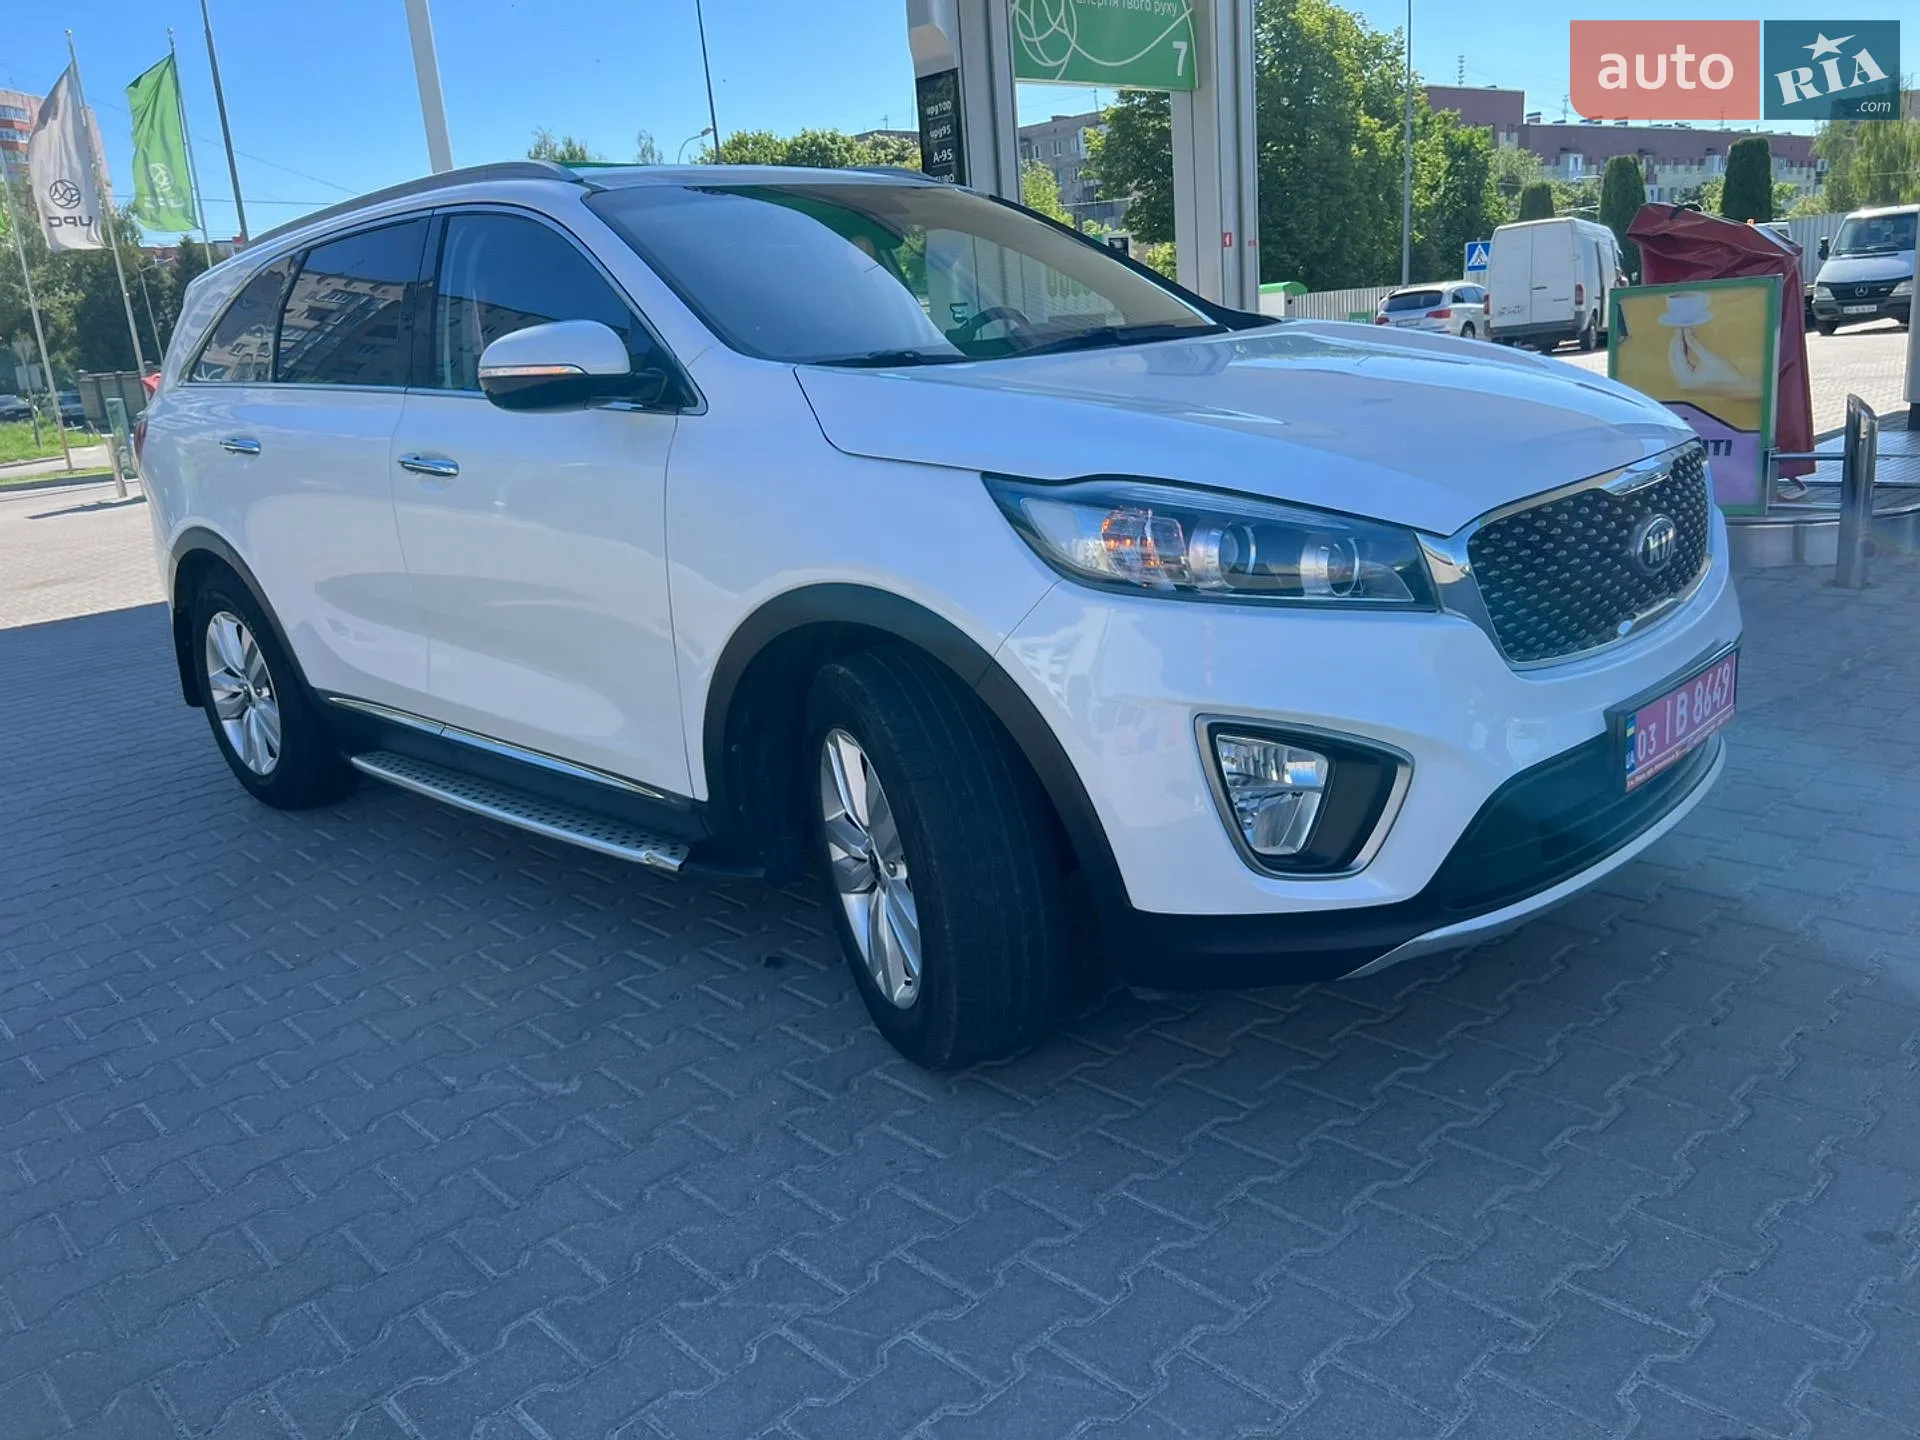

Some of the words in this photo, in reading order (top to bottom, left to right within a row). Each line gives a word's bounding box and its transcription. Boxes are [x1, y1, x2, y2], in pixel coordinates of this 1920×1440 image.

[1076, 0, 1119, 9] ергія
[1154, 1, 1177, 17] руху
[1172, 41, 1188, 77] 7
[933, 148, 953, 163] A-95
[1637, 722, 1657, 762] 03
[1692, 662, 1731, 724] 8649
